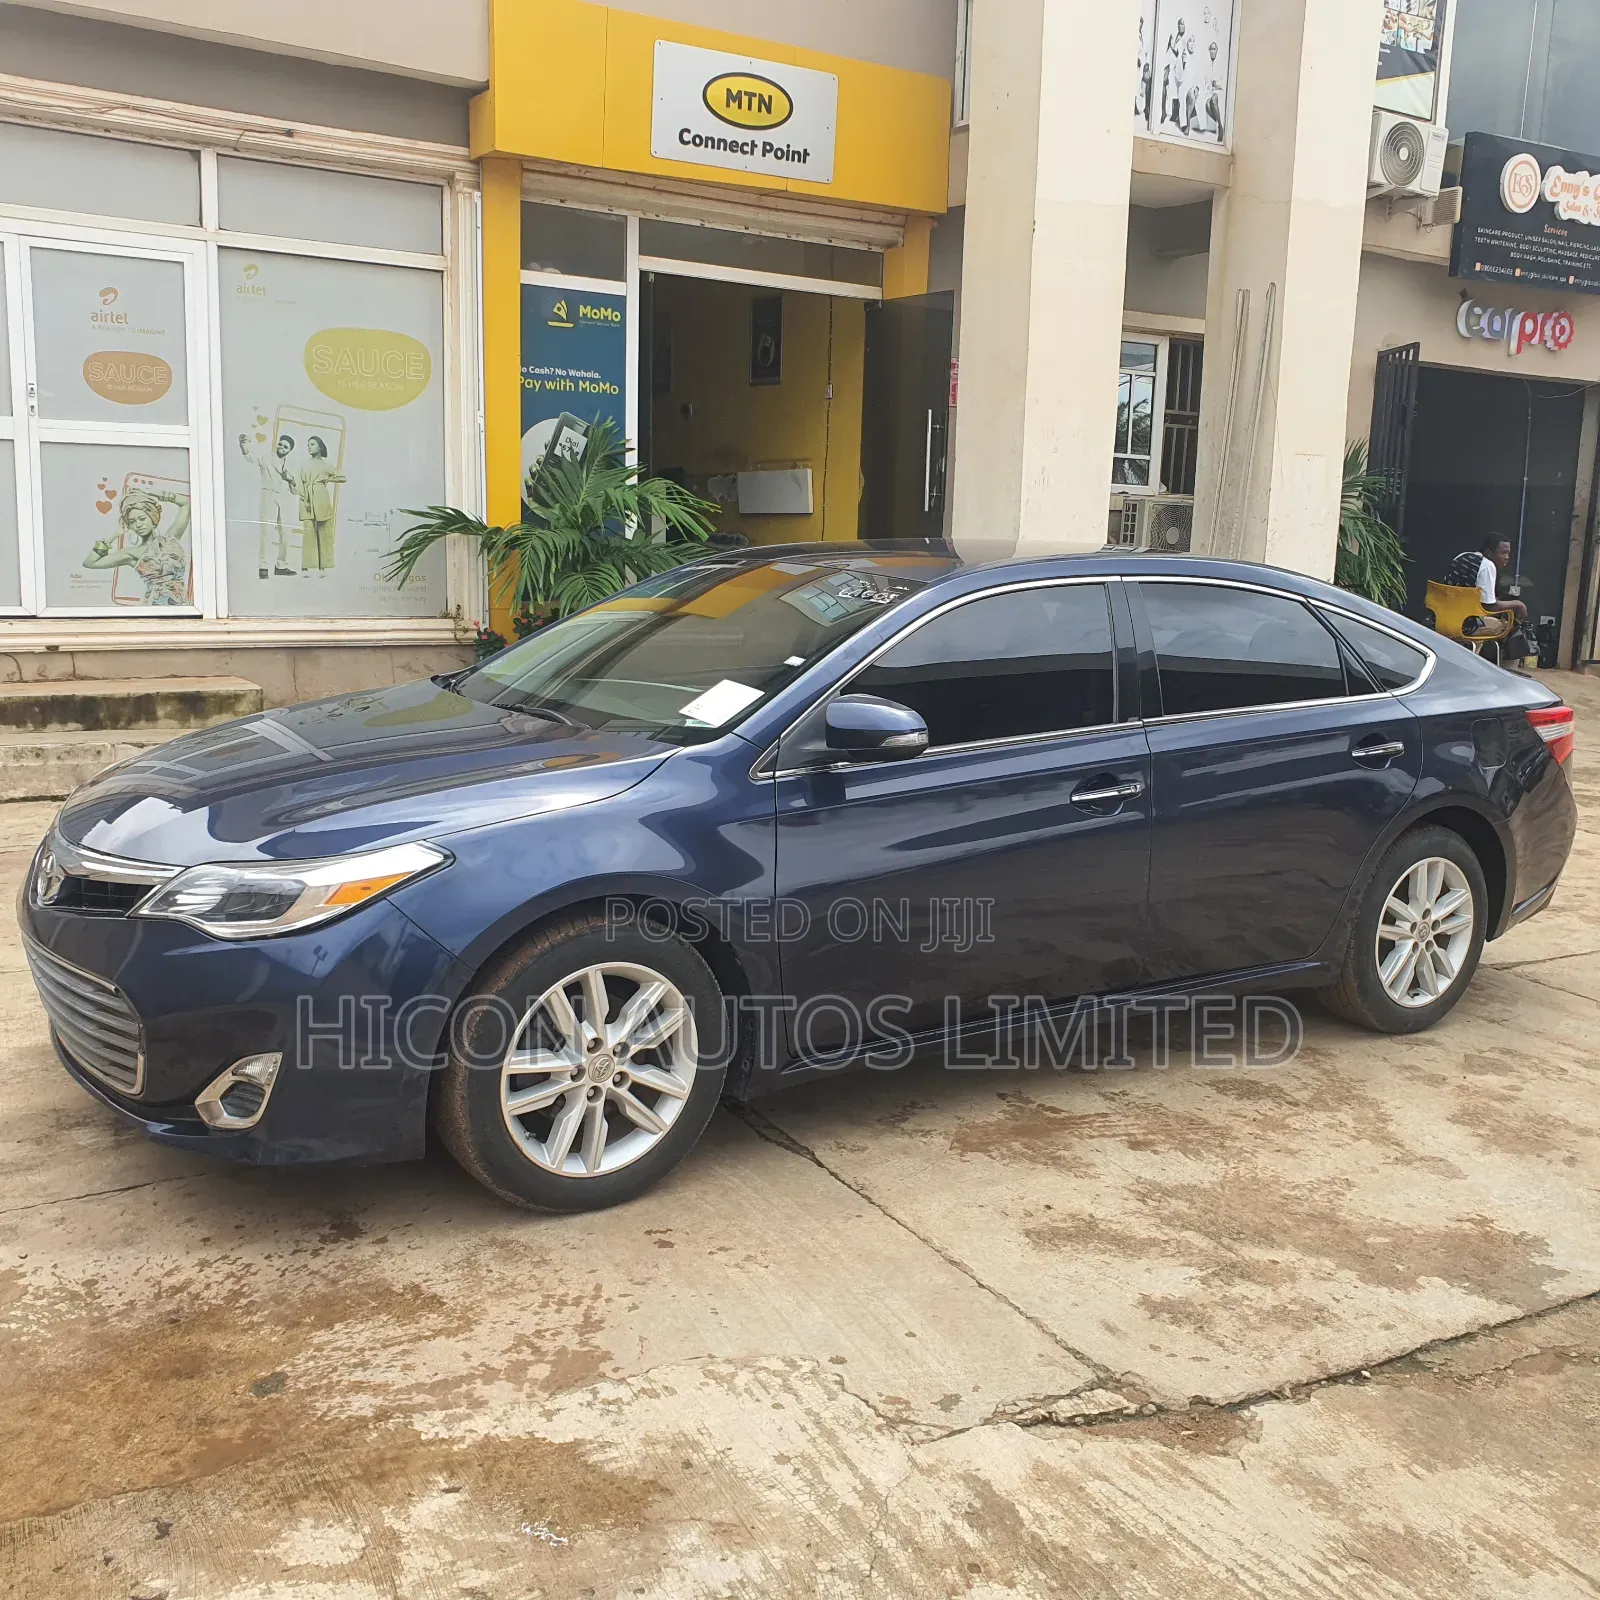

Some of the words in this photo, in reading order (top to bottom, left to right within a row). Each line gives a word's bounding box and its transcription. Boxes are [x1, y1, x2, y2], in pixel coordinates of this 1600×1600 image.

[726, 88, 773, 115] MTN
[678, 128, 758, 156] Connect
[761, 141, 811, 164] Point
[1544, 224, 1568, 237] Services
[236, 282, 267, 296] airtel
[90, 308, 129, 325] airtel
[579, 304, 622, 322] MoMo
[312, 344, 425, 380] SAUCE
[88, 361, 168, 385] SAUCE
[529, 365, 553, 376] Cash?
[555, 368, 567, 376] No
[568, 369, 602, 379] Wahala.
[348, 380, 366, 389] HER
[367, 381, 404, 391] REASON
[519, 375, 541, 392] Pay
[545, 377, 575, 392] with
[579, 379, 620, 395] MoMo
[396, 573, 427, 585] Lgos
